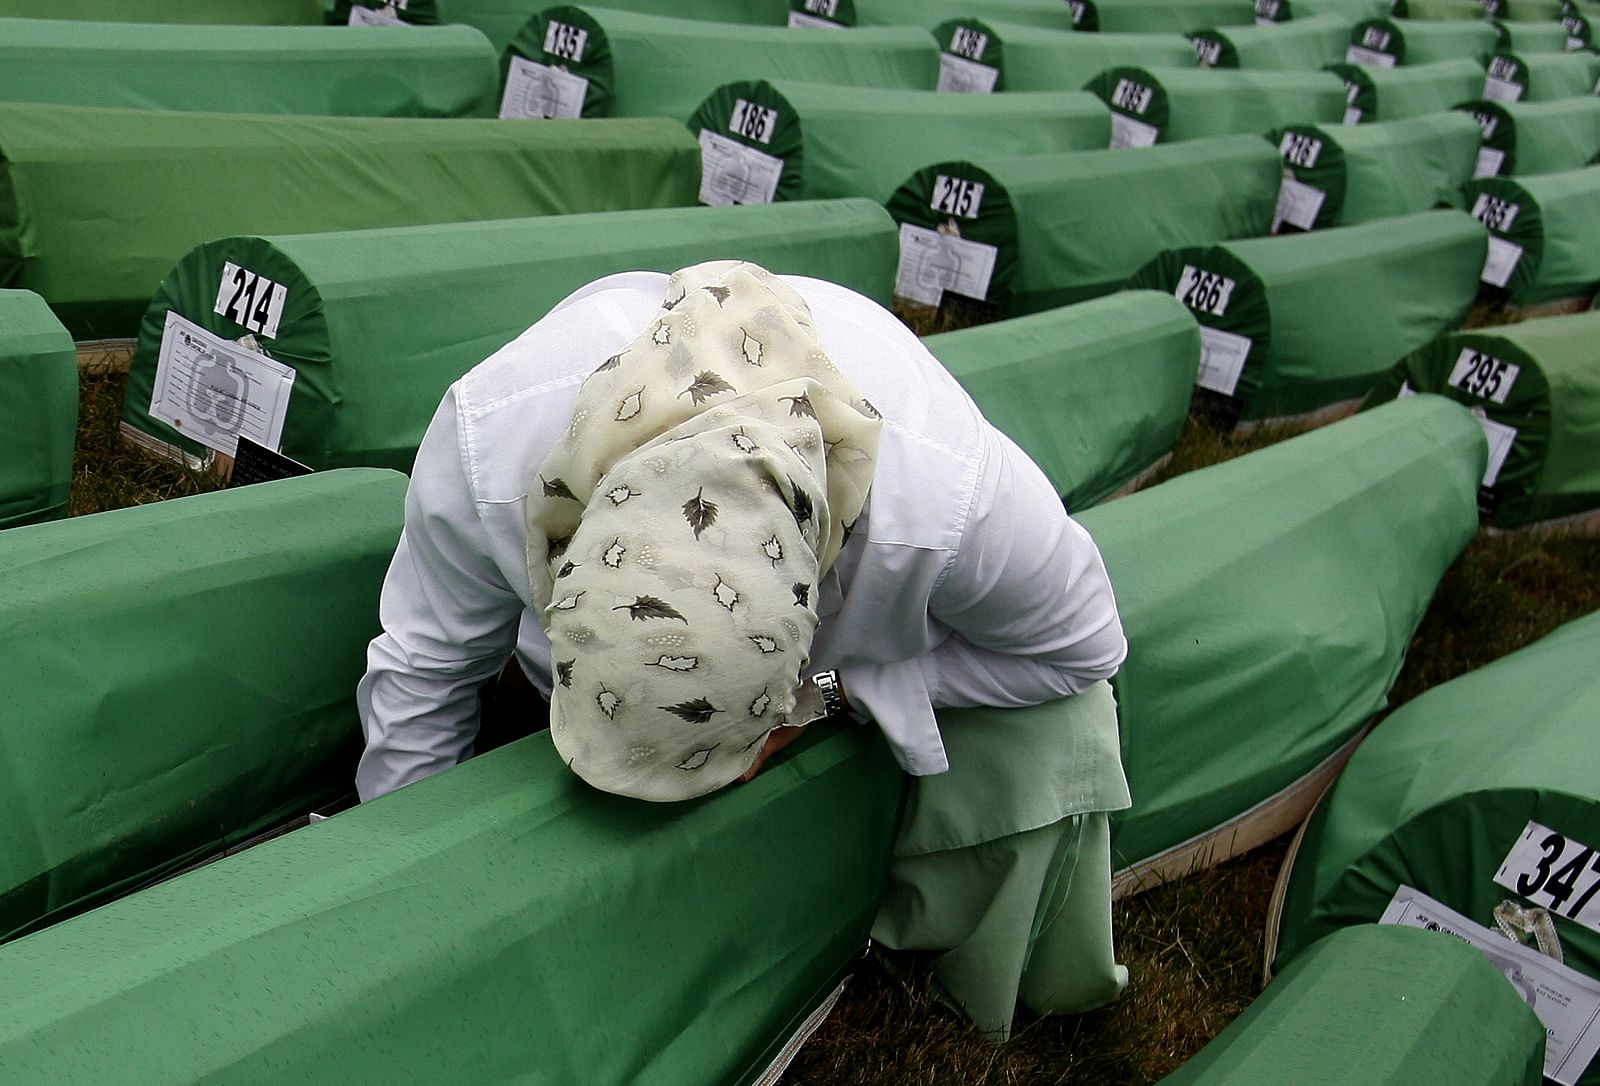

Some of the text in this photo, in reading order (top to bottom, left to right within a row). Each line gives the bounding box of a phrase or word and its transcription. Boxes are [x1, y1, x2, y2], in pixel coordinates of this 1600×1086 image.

[553, 24, 579, 58] 135
[739, 103, 768, 139] 186
[939, 178, 974, 216] 215
[225, 268, 275, 333] 214
[1185, 270, 1224, 310] 266
[1458, 352, 1507, 398] 295
